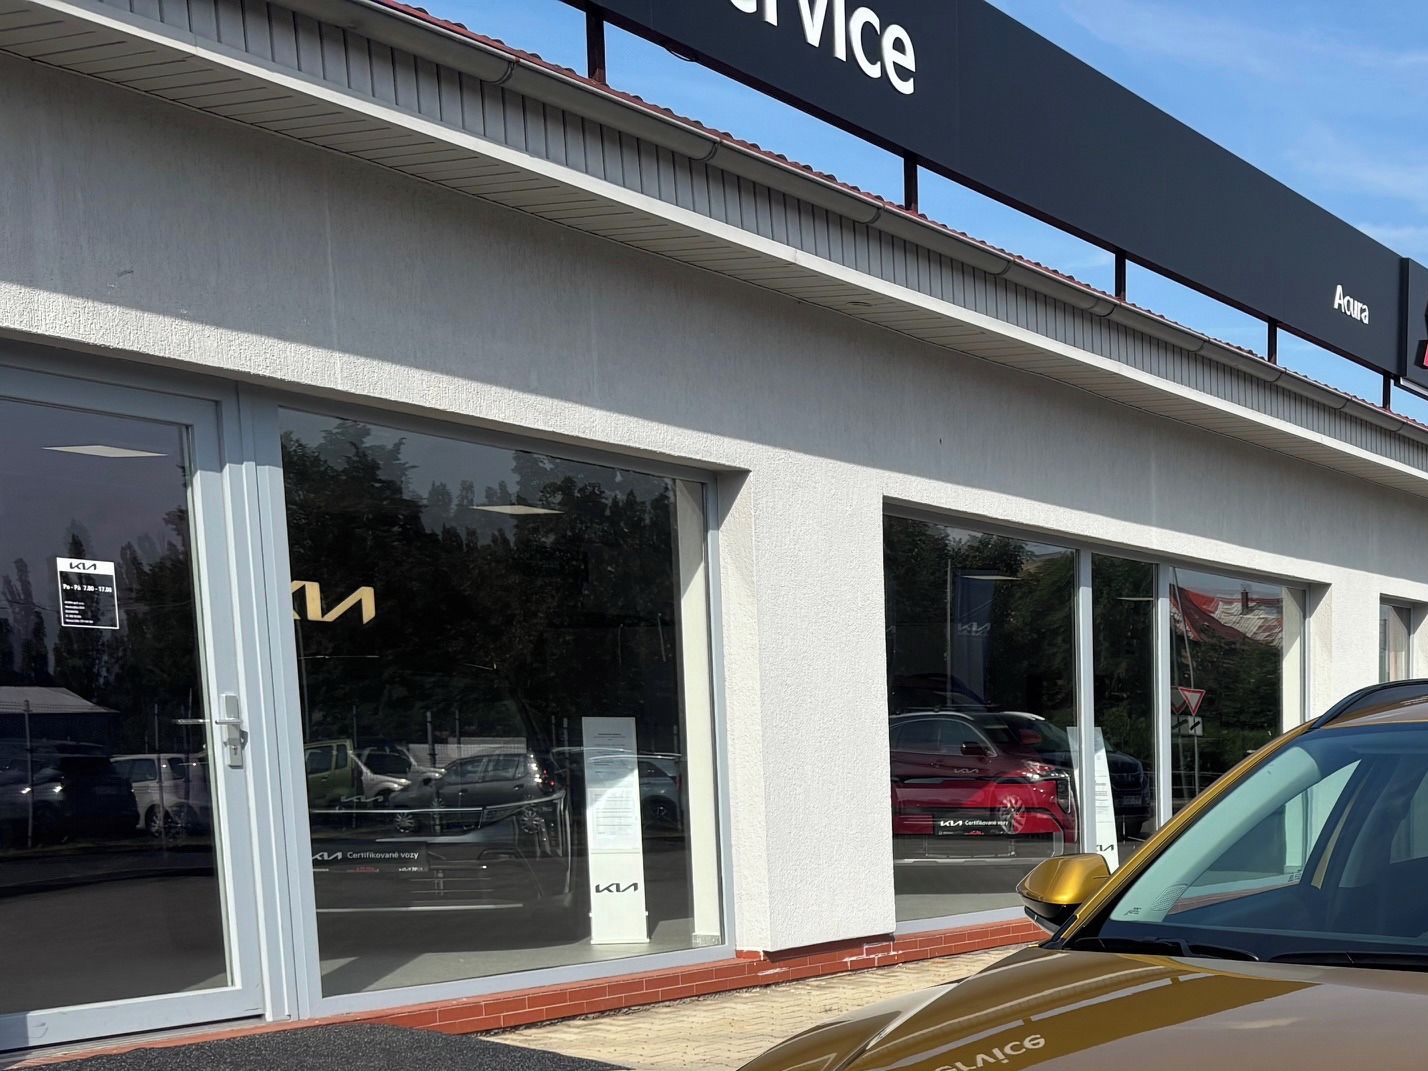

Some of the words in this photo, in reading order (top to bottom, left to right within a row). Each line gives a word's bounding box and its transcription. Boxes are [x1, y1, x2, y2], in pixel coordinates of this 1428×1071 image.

[730, 0, 916, 95] vice
[1333, 284, 1369, 325] Acura
[69, 562, 97, 571] KIA
[595, 882, 639, 893] KIA
